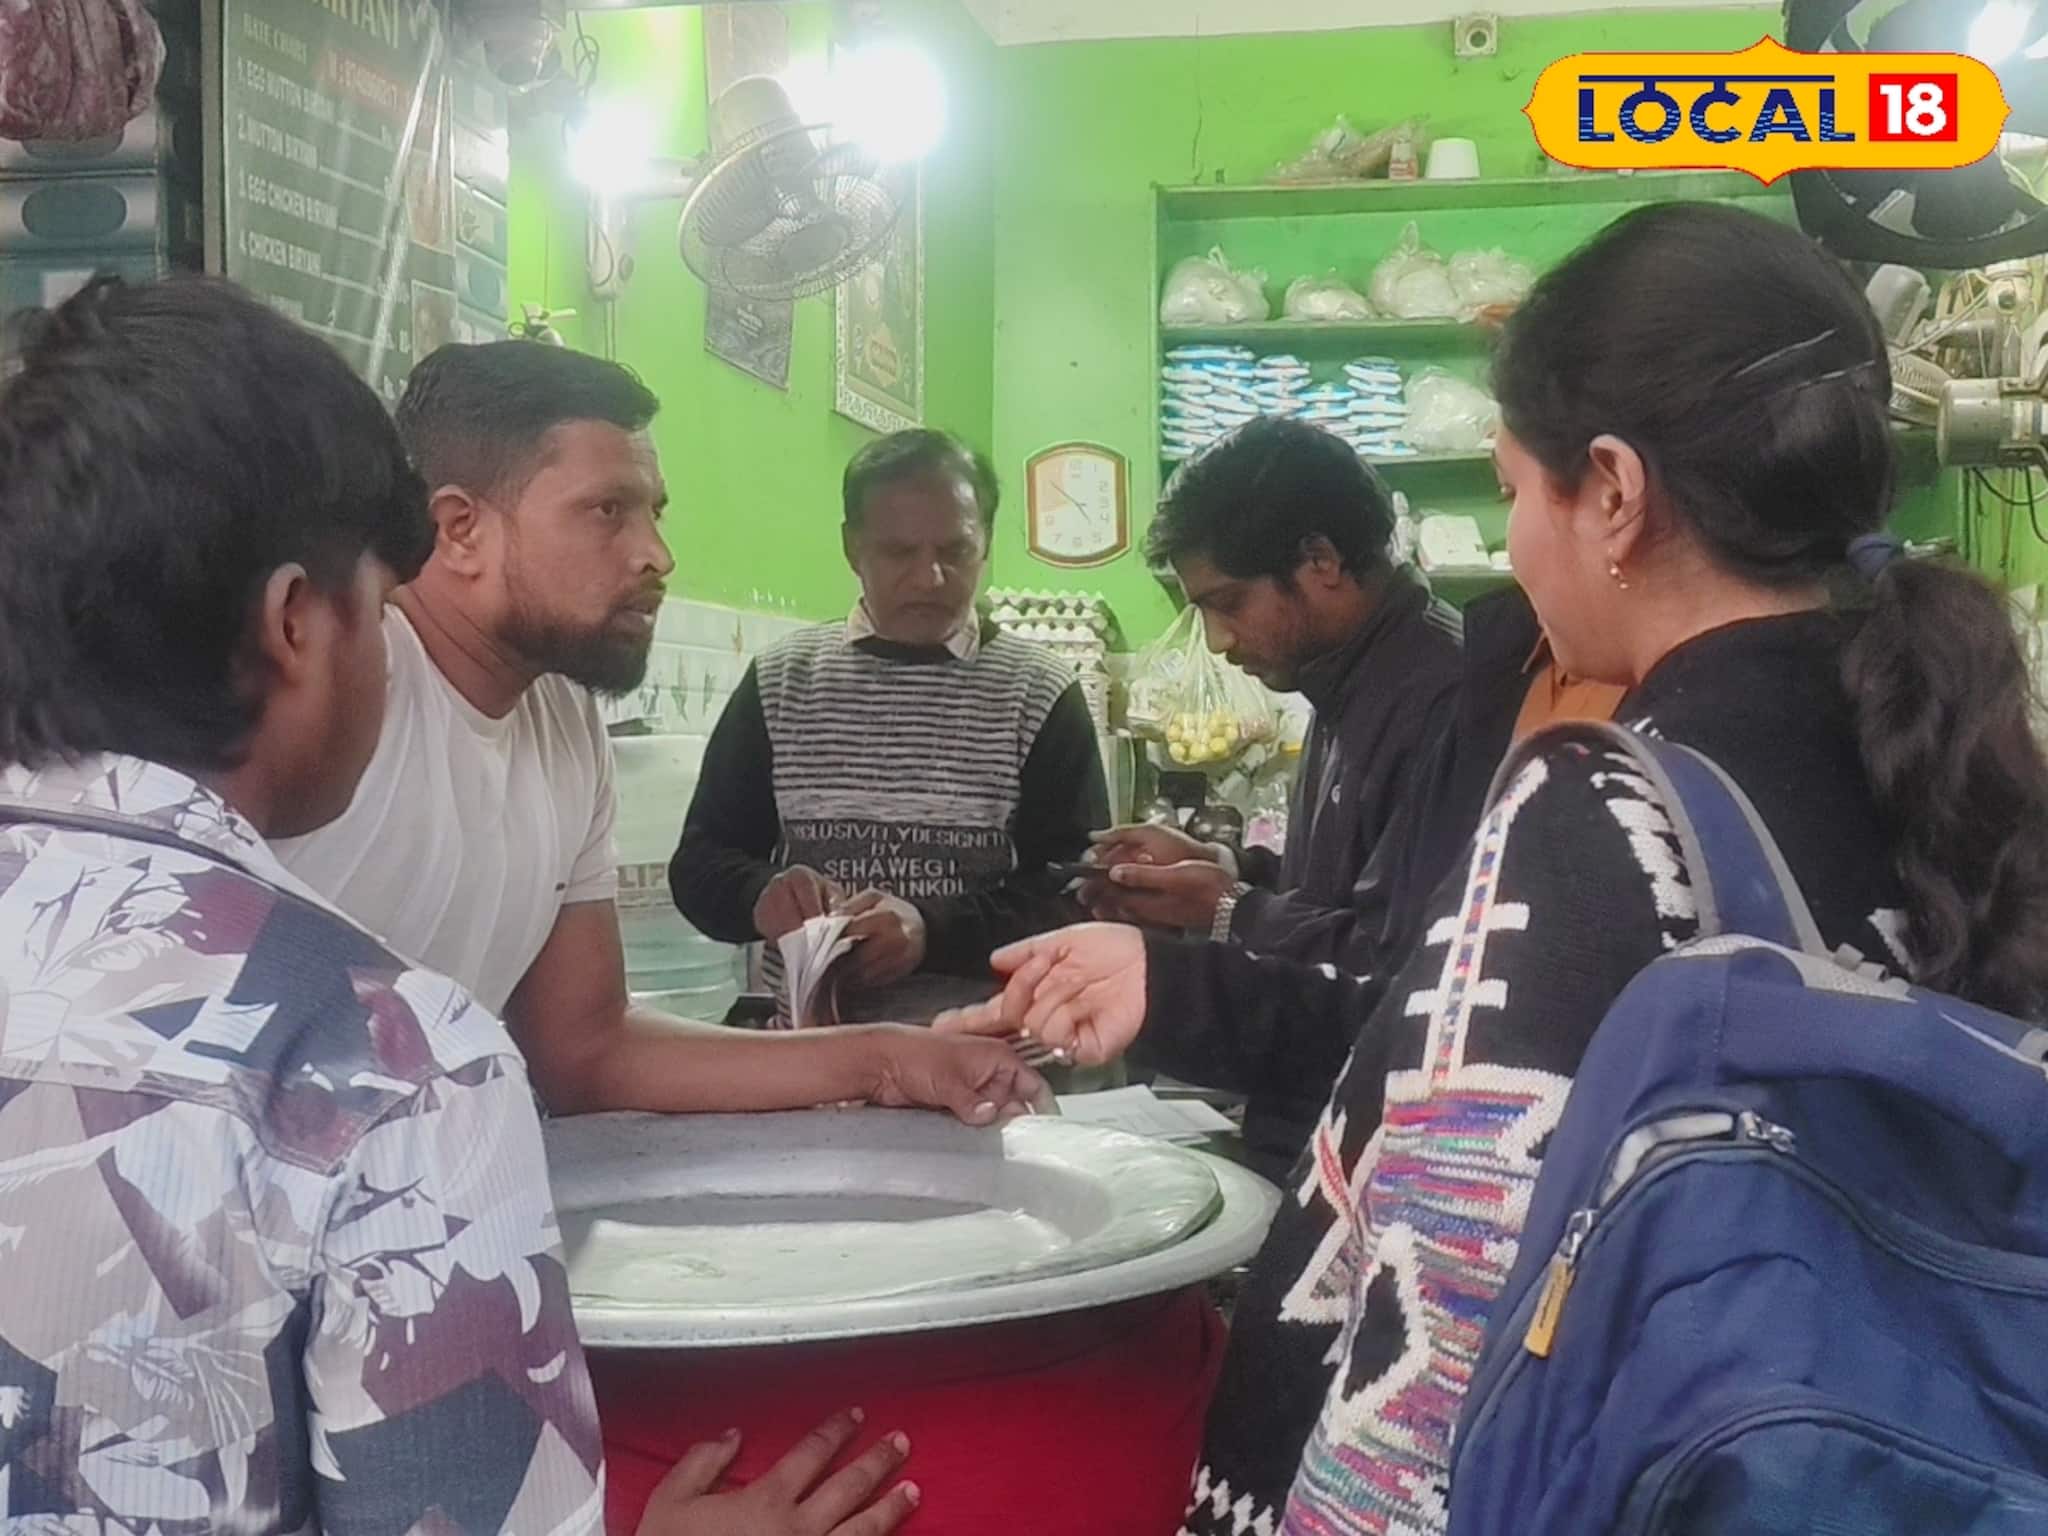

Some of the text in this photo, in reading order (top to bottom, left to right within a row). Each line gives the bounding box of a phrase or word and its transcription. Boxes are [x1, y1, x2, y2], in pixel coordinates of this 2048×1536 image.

[246, 60, 266, 93] EGG
[247, 172, 267, 205] EGG
[248, 231, 288, 267] CHICKEN
